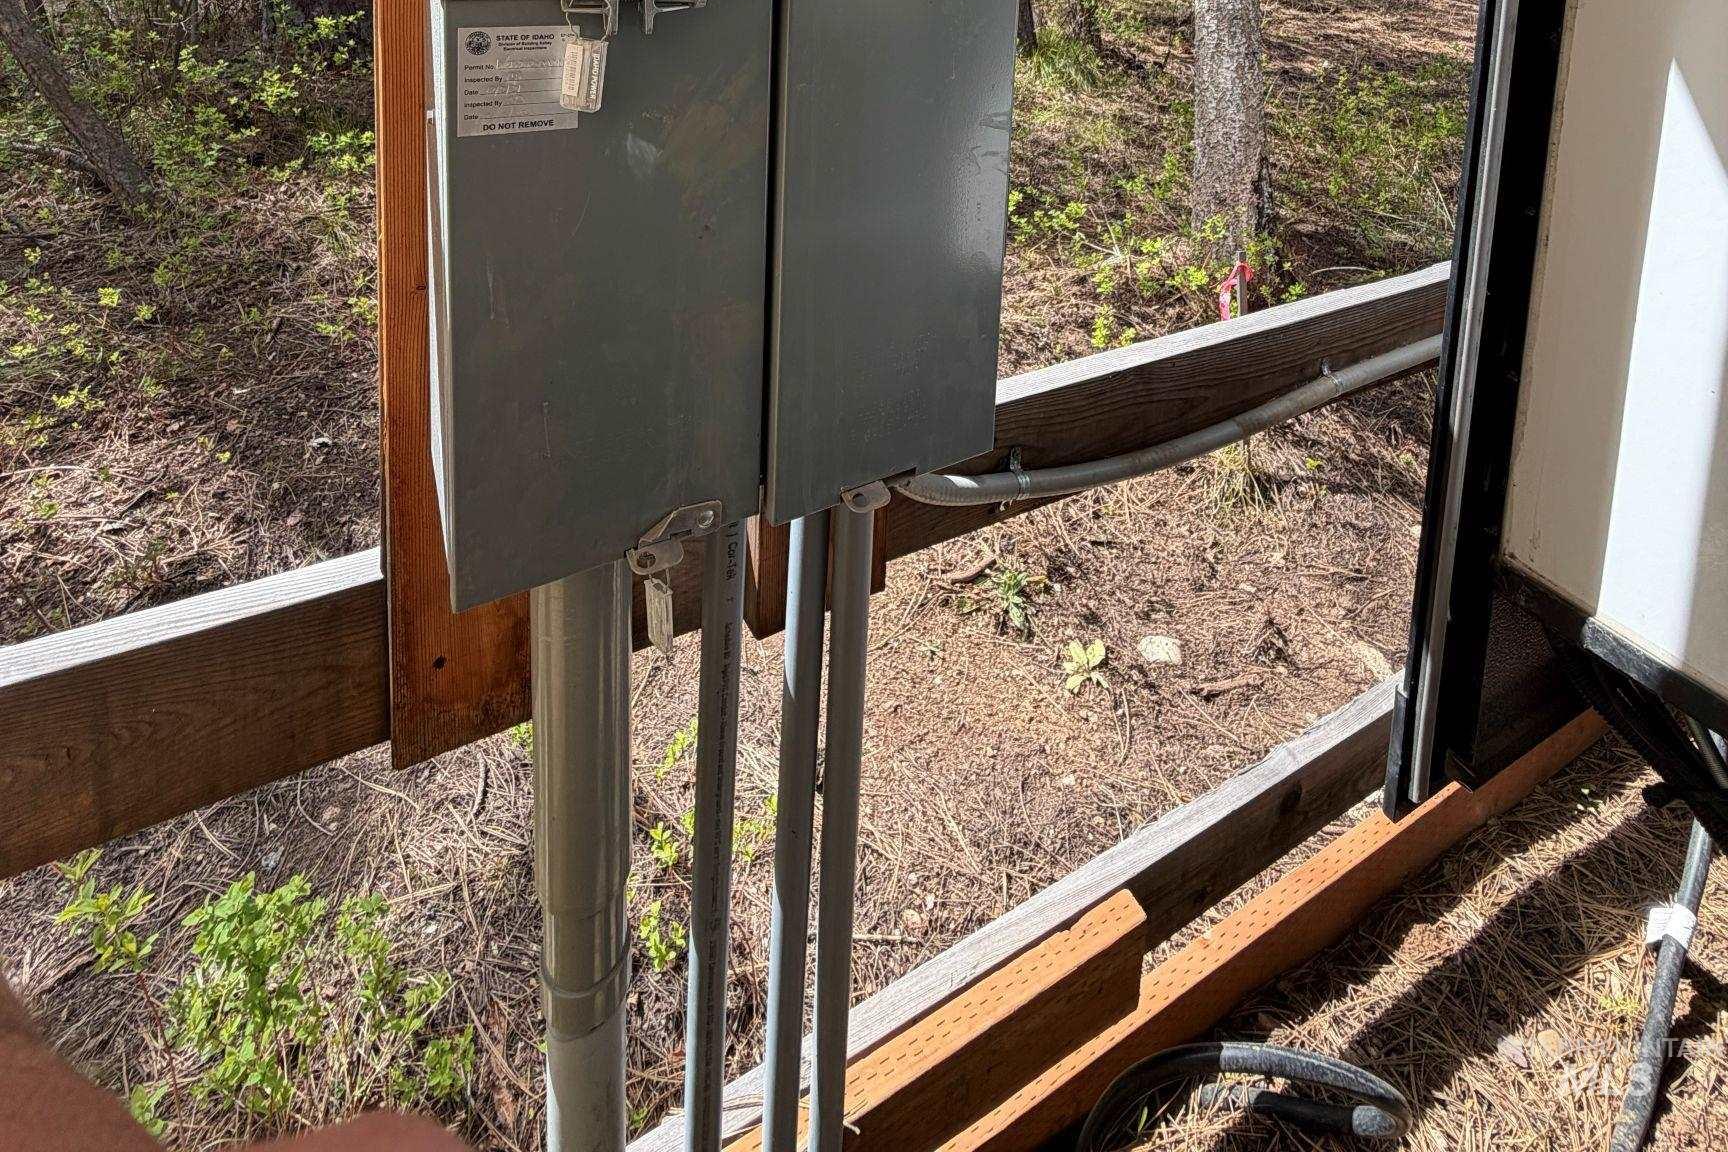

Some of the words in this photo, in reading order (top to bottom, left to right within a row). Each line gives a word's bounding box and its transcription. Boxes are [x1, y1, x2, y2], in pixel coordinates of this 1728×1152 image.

[496, 34, 519, 42] STATE
[464, 76, 493, 84] Inspected
[494, 75, 503, 83] By
[464, 101, 493, 109] Inspected
[494, 100, 503, 108] By
[483, 123, 496, 131] DO
[498, 122, 517, 130] NOT
[518, 119, 555, 129] REMOVE
